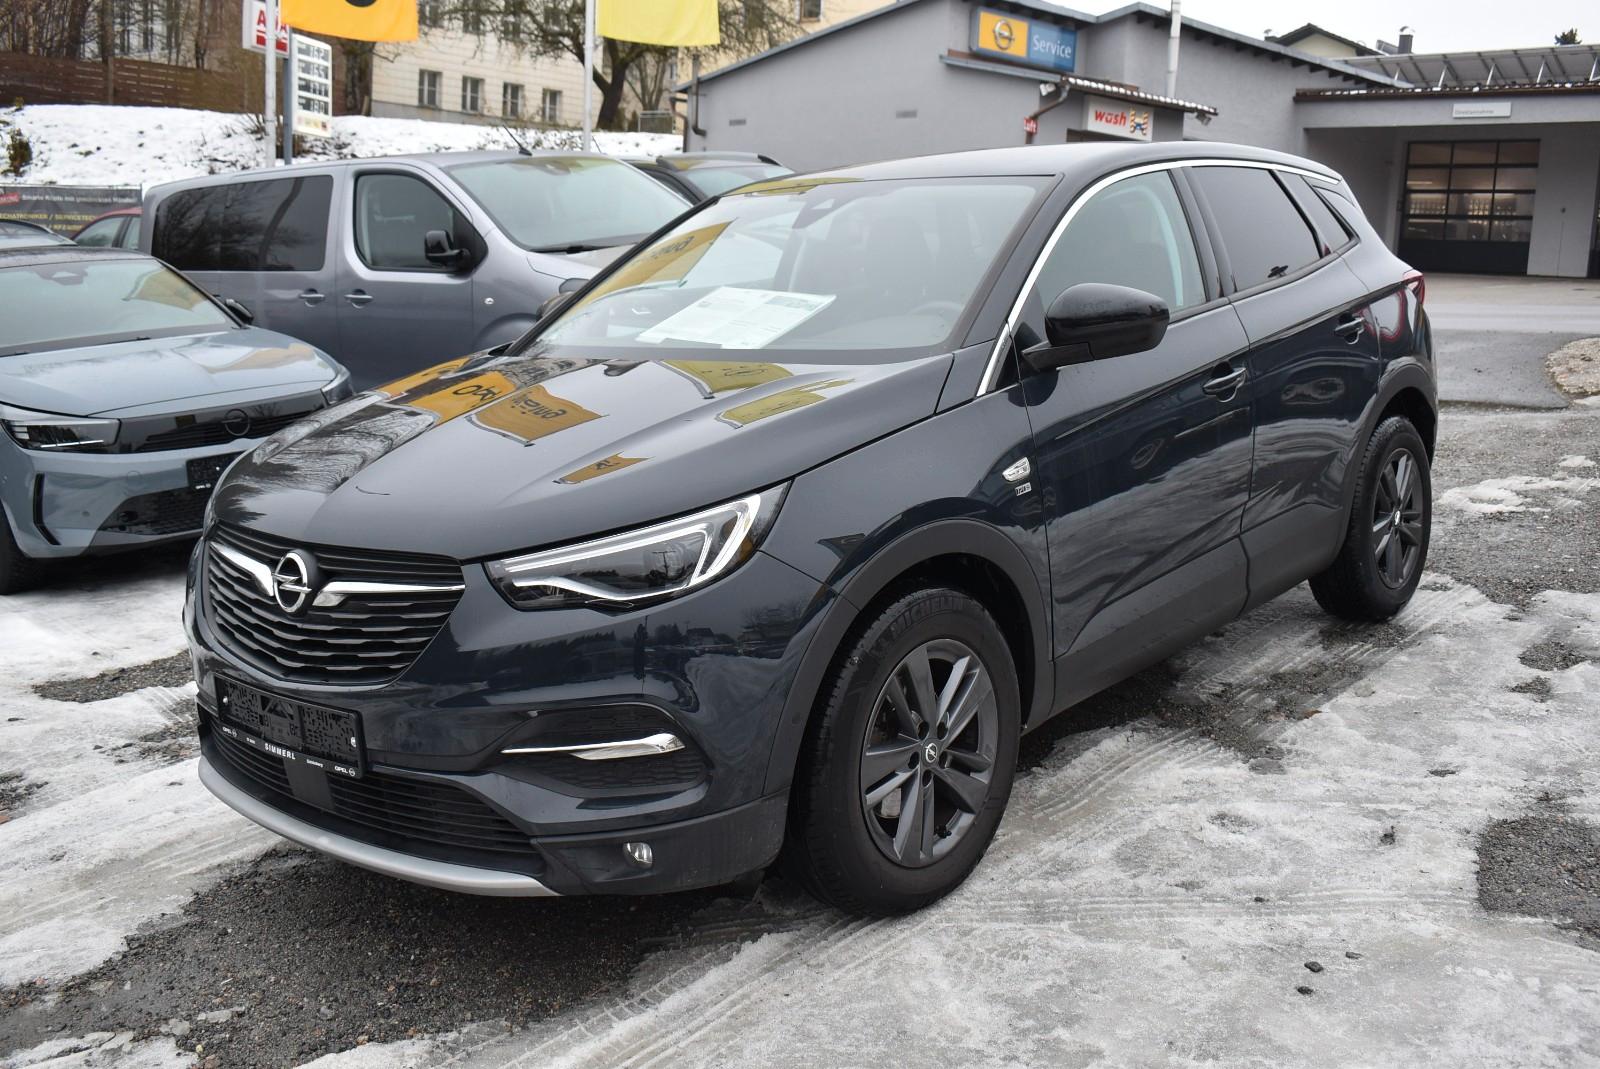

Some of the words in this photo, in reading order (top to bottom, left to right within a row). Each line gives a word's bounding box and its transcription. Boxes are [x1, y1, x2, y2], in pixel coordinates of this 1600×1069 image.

[257, 10, 288, 33] AIA
[1032, 35, 1072, 59] Service
[1094, 109, 1128, 127] wash
[264, 742, 296, 760] SIMMERL
